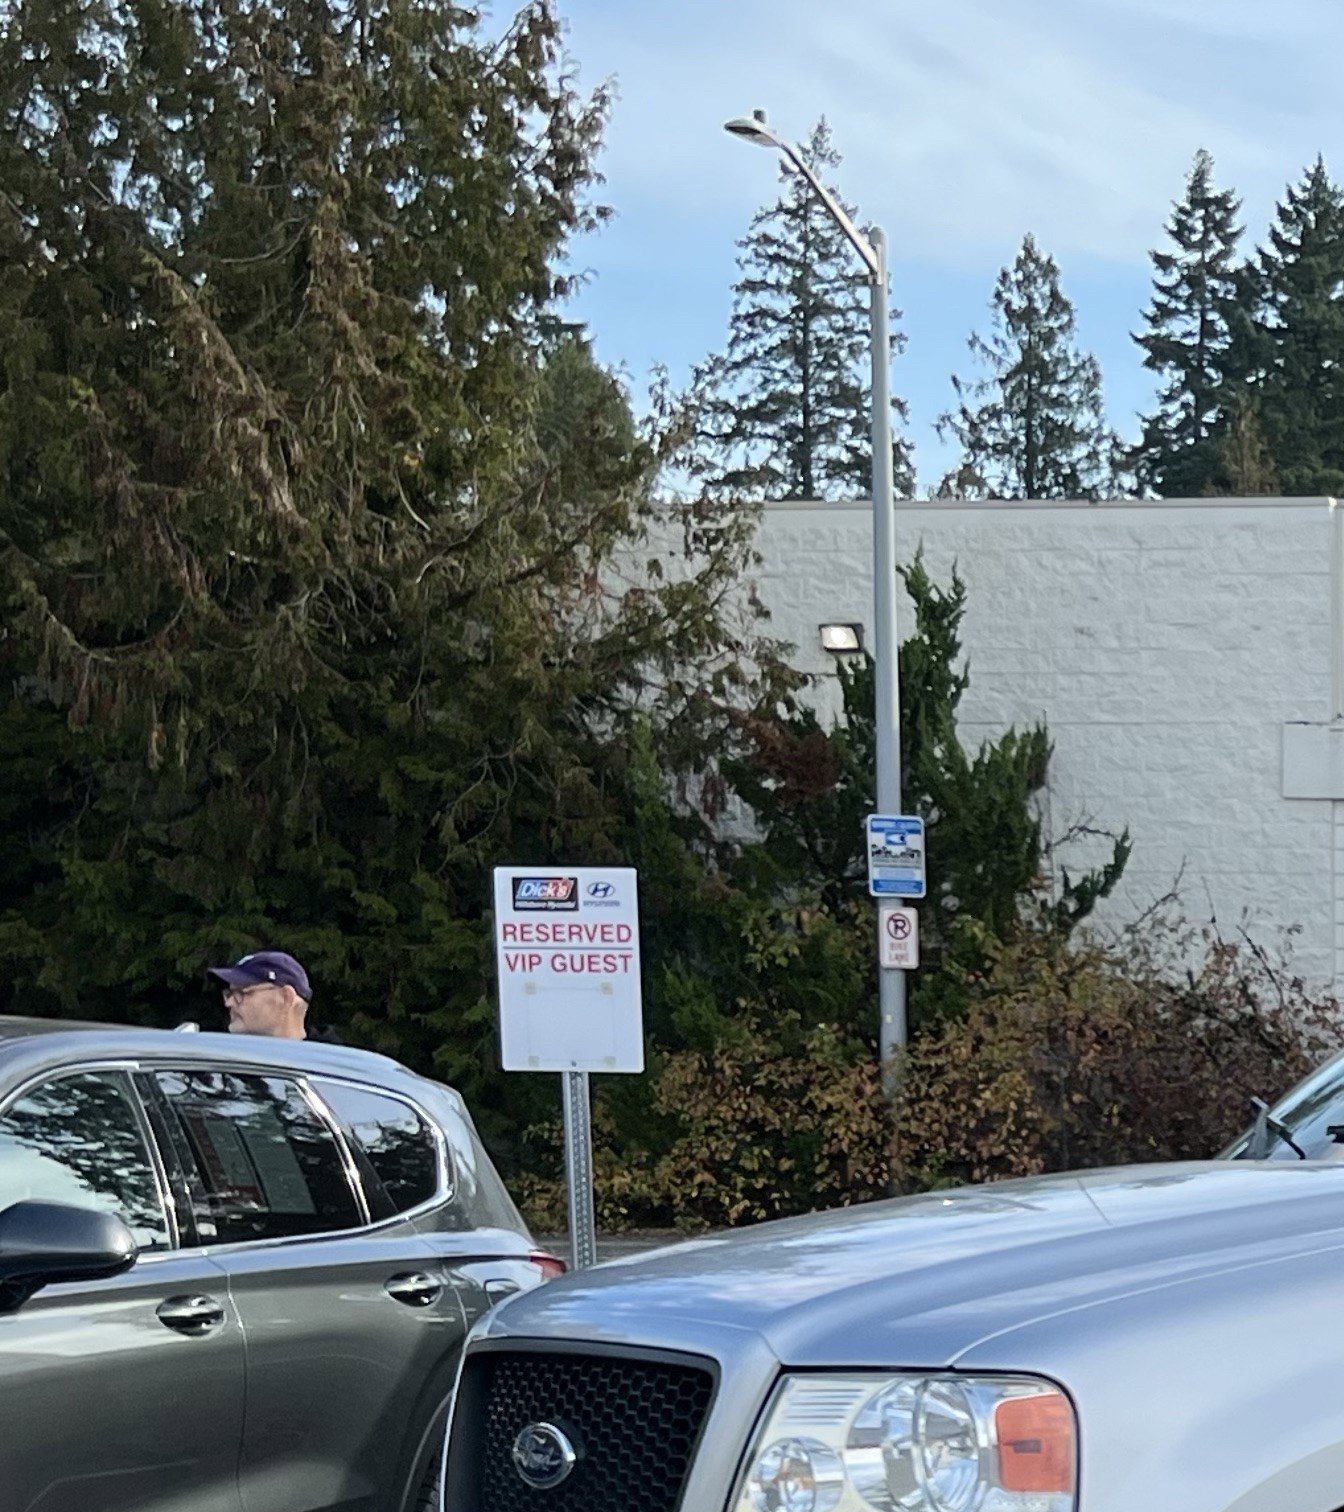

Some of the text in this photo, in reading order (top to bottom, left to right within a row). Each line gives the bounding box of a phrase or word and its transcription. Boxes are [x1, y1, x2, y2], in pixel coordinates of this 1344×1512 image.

[502, 923, 632, 943] RESERVED
[504, 953, 633, 973] VIP GUEST
